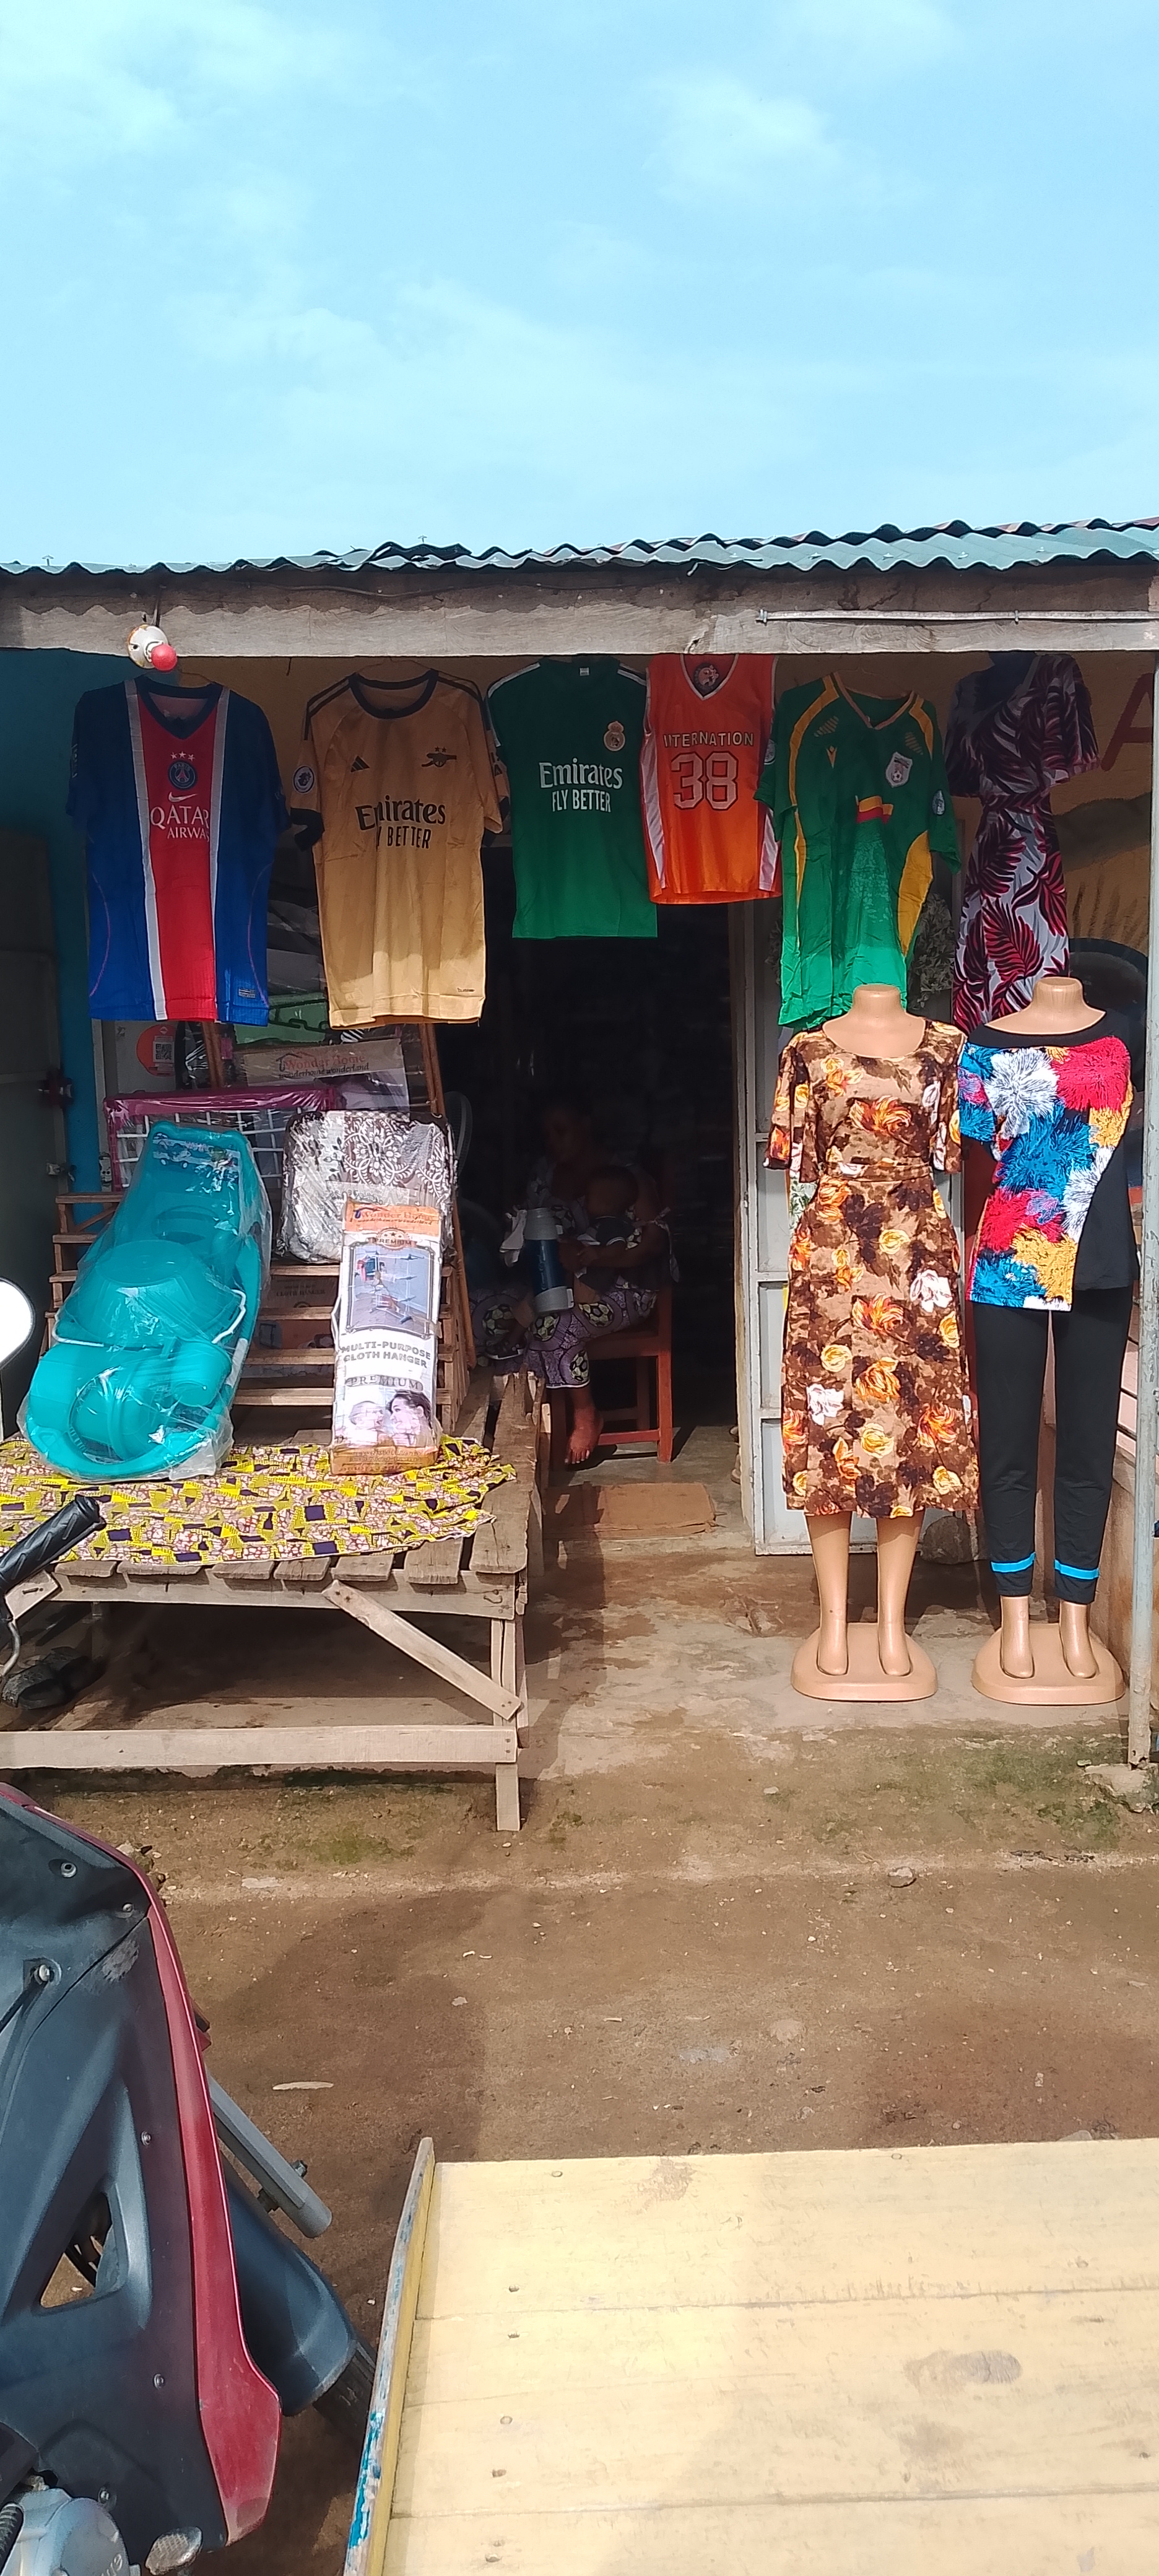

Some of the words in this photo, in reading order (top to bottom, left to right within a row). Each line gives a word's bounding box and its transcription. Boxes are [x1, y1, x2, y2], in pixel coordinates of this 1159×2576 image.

[539, 757, 623, 789] Emirates
[671, 751, 739, 811] 38
[552, 789, 569, 812] FLY
[572, 789, 611, 812] BETTER
[150, 804, 209, 830] QATAR
[388, 826, 432, 848] BETTER
[341, 1341, 431, 1360] MULTI-PURPOSE
[344, 1352, 380, 1362] CLOTH
[383, 1352, 427, 1368] HANGER
[350, 1375, 419, 1390] PREMIUM
